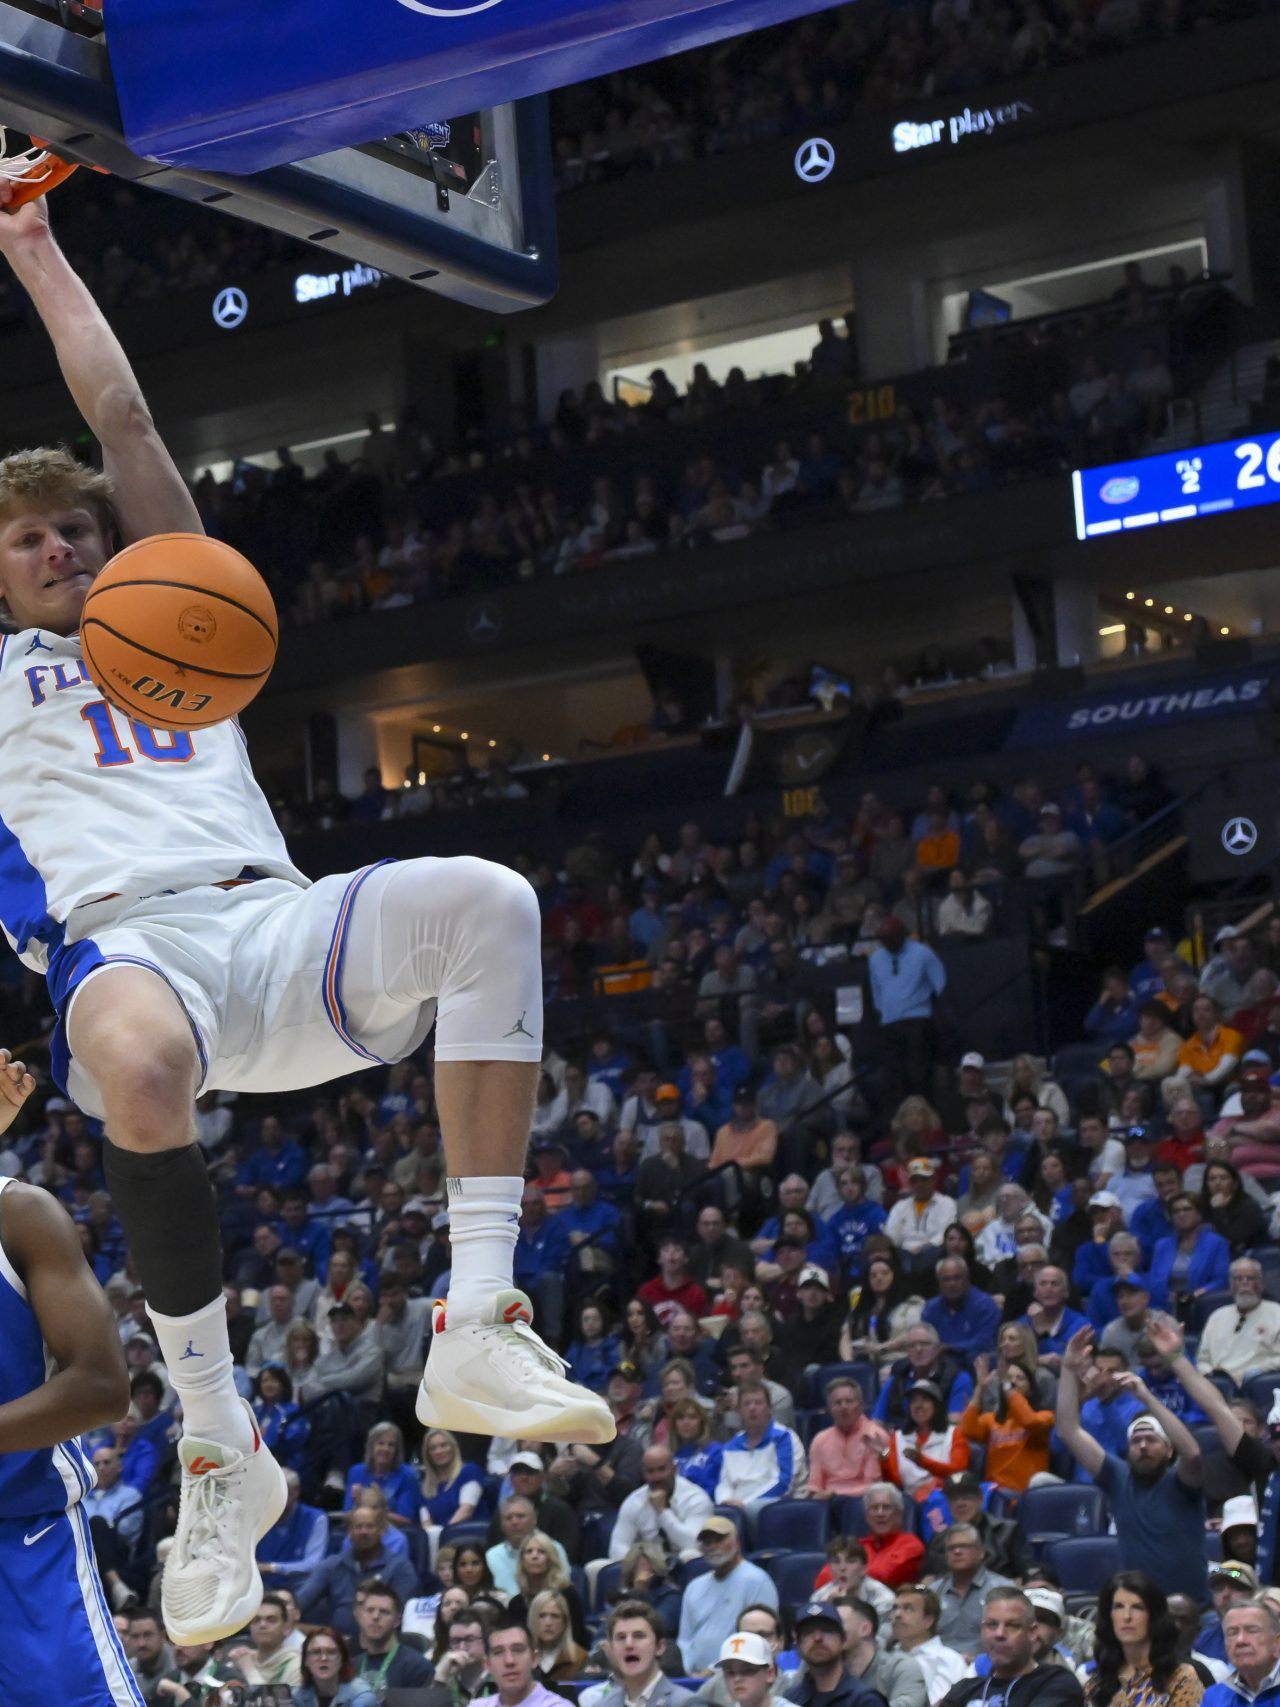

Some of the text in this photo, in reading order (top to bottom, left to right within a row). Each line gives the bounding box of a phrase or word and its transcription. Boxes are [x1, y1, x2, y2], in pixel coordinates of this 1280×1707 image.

[893, 121, 945, 152] Star
[296, 273, 340, 302] Star
[1181, 470, 1201, 494] 2
[131, 675, 213, 712] EVO
[1067, 679, 1269, 730] SOUTHEAS
[80, 698, 196, 768] 10
